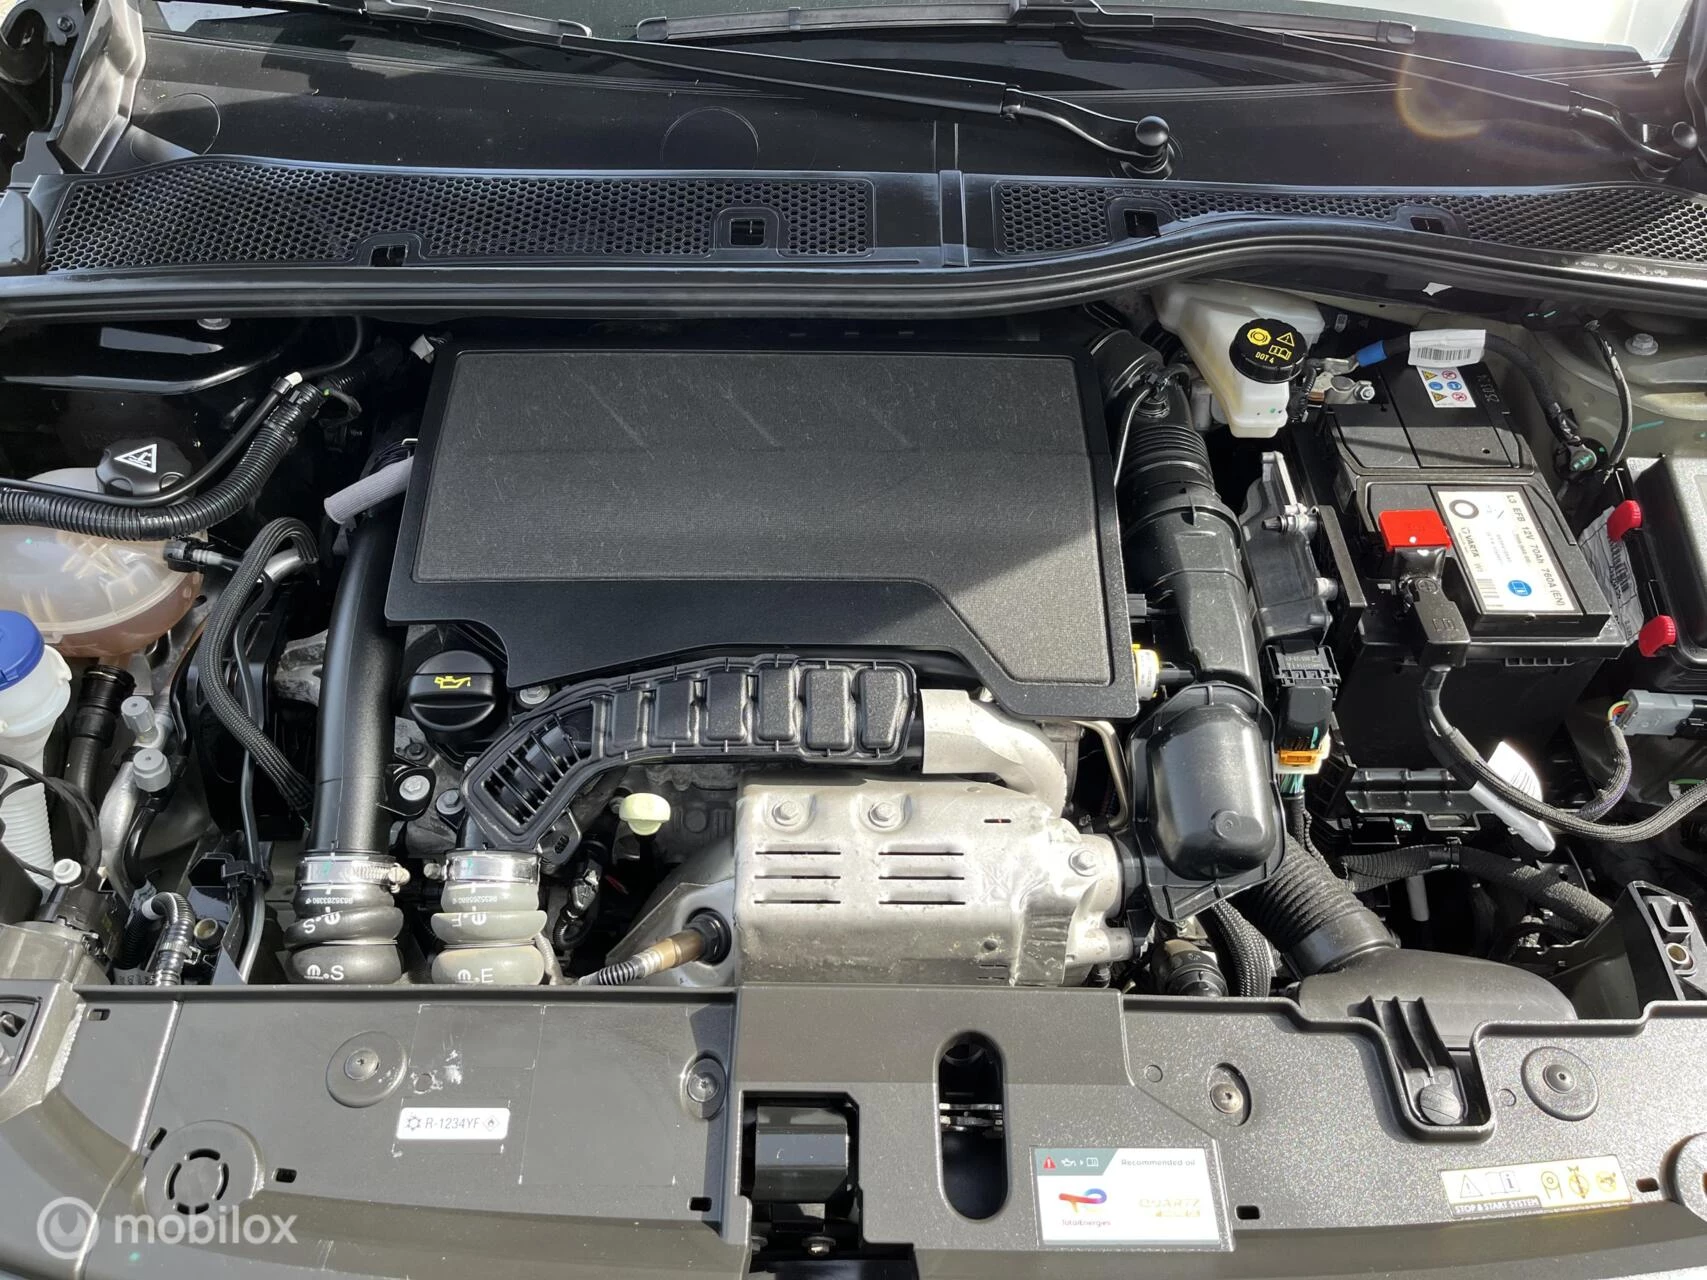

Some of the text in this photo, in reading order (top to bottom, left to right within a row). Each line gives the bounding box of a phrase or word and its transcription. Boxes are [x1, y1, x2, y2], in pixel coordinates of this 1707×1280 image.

[1255, 351, 1269, 361] DOT
[1465, 535, 1481, 558] VARTA
[1507, 494, 1518, 504] L3
[1513, 508, 1526, 522] EFB
[1522, 526, 1535, 540] 12V
[1530, 544, 1545, 564] 70Ah
[1541, 567, 1557, 588] 760A
[1551, 587, 1566, 607] (EN)
[425, 1117, 481, 1129] R-1234YF
[1121, 1158, 1196, 1167] Recommended oil
[1454, 1204, 1476, 1214] STOP
[1483, 1201, 1508, 1211] START
[1508, 1197, 1540, 1208] SYSTEM
